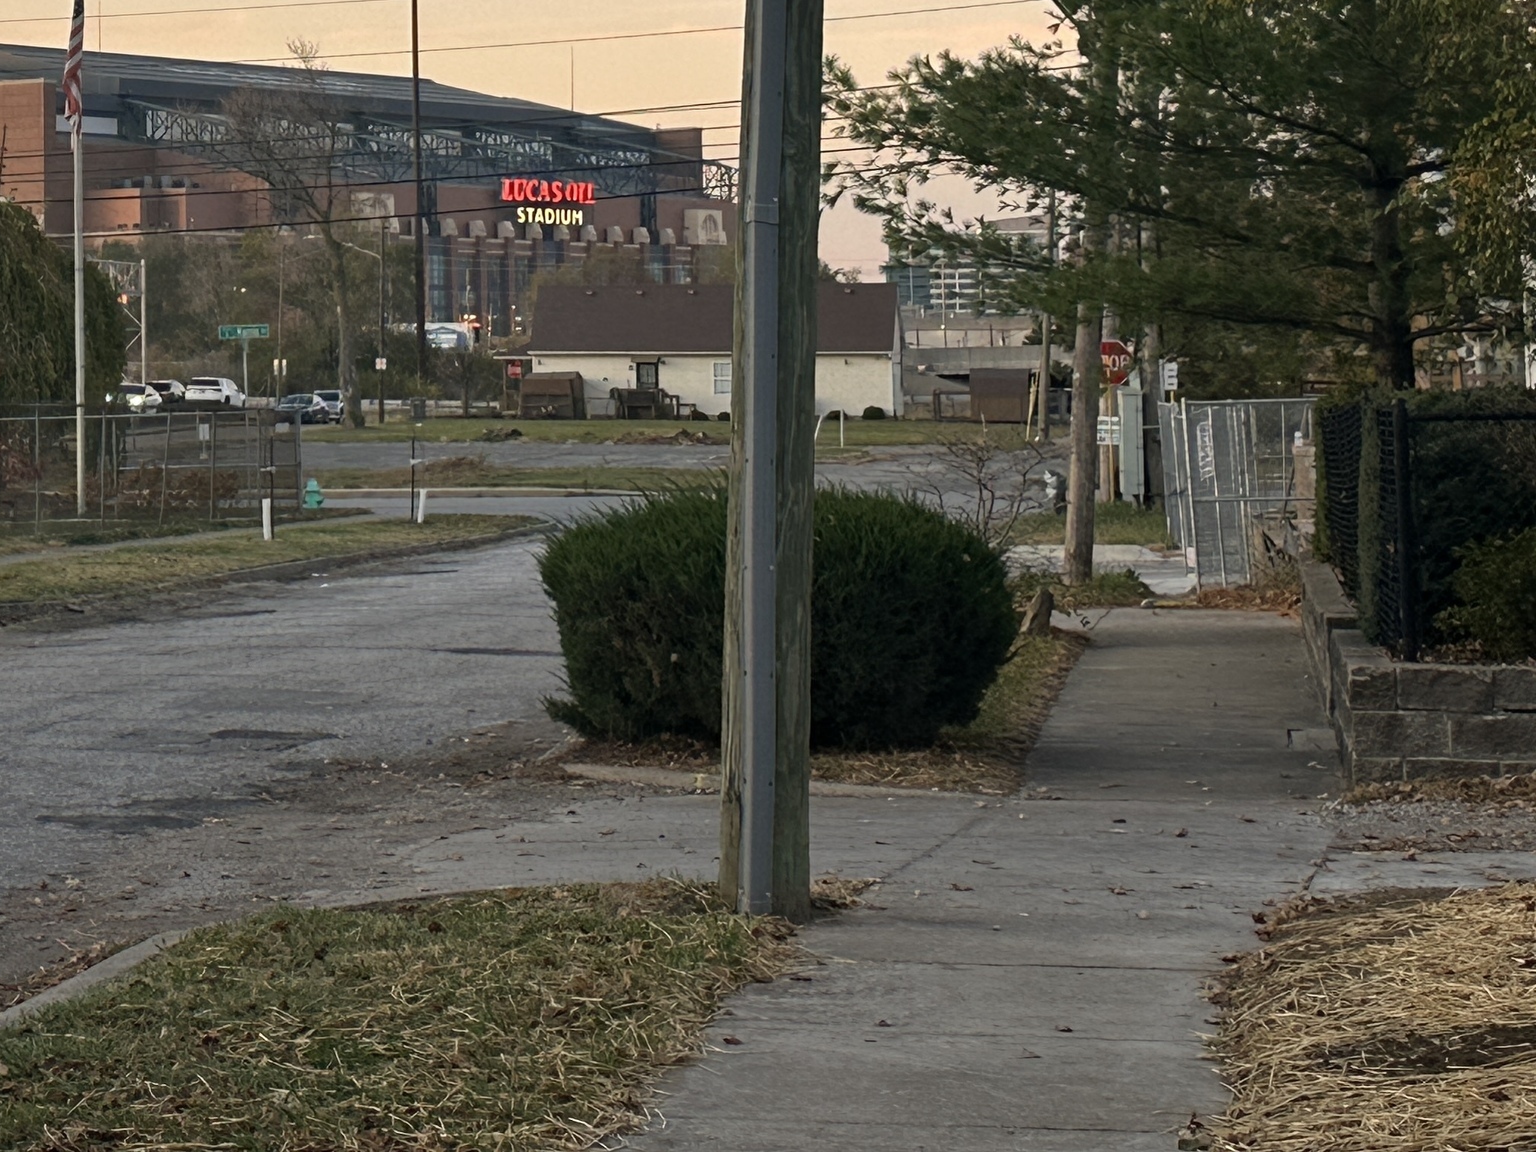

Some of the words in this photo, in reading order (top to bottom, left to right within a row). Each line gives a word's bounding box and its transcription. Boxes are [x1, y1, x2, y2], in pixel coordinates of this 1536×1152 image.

[501, 178, 563, 203] LUCAS
[565, 181, 597, 204] OIL
[517, 207, 583, 226] STADIUM
[1101, 354, 1130, 371] TOP
